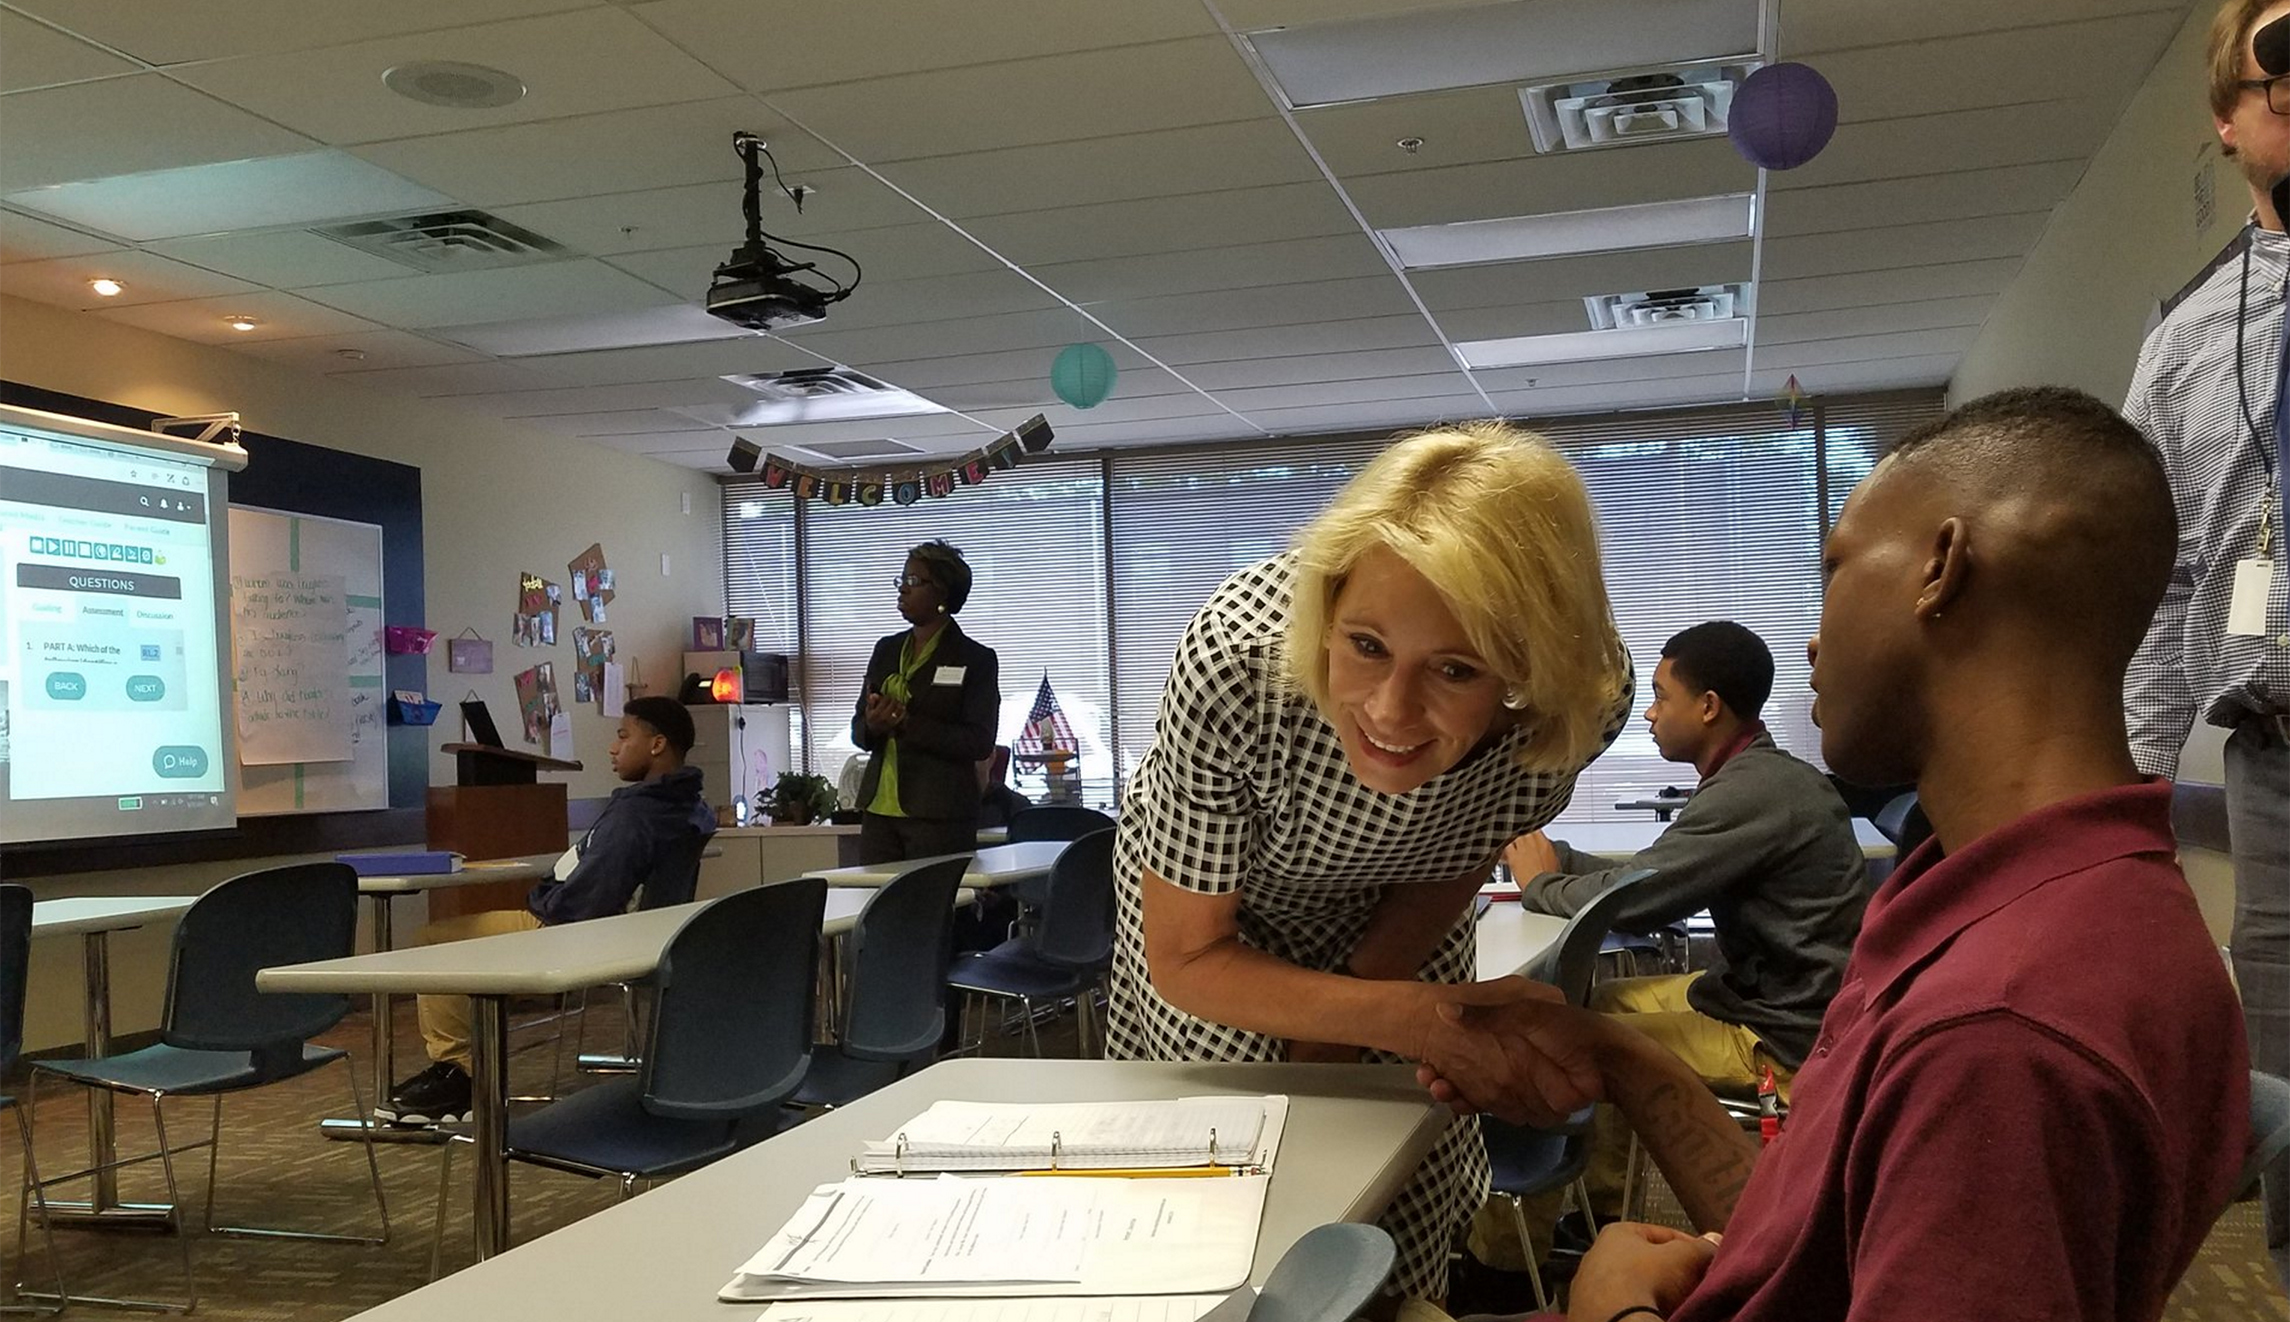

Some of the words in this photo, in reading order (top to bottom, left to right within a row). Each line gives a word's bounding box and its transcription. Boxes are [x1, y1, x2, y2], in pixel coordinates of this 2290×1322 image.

[68, 575, 135, 591] QUESTIONS
[82, 605, 124, 618] Assessment
[136, 610, 174, 620] Discussion
[43, 641, 67, 652] PART
[76, 644, 100, 654] Which
[108, 645, 121, 655] the
[54, 681, 79, 691] BACK
[133, 683, 157, 693] NEXT
[178, 756, 198, 768] Help
